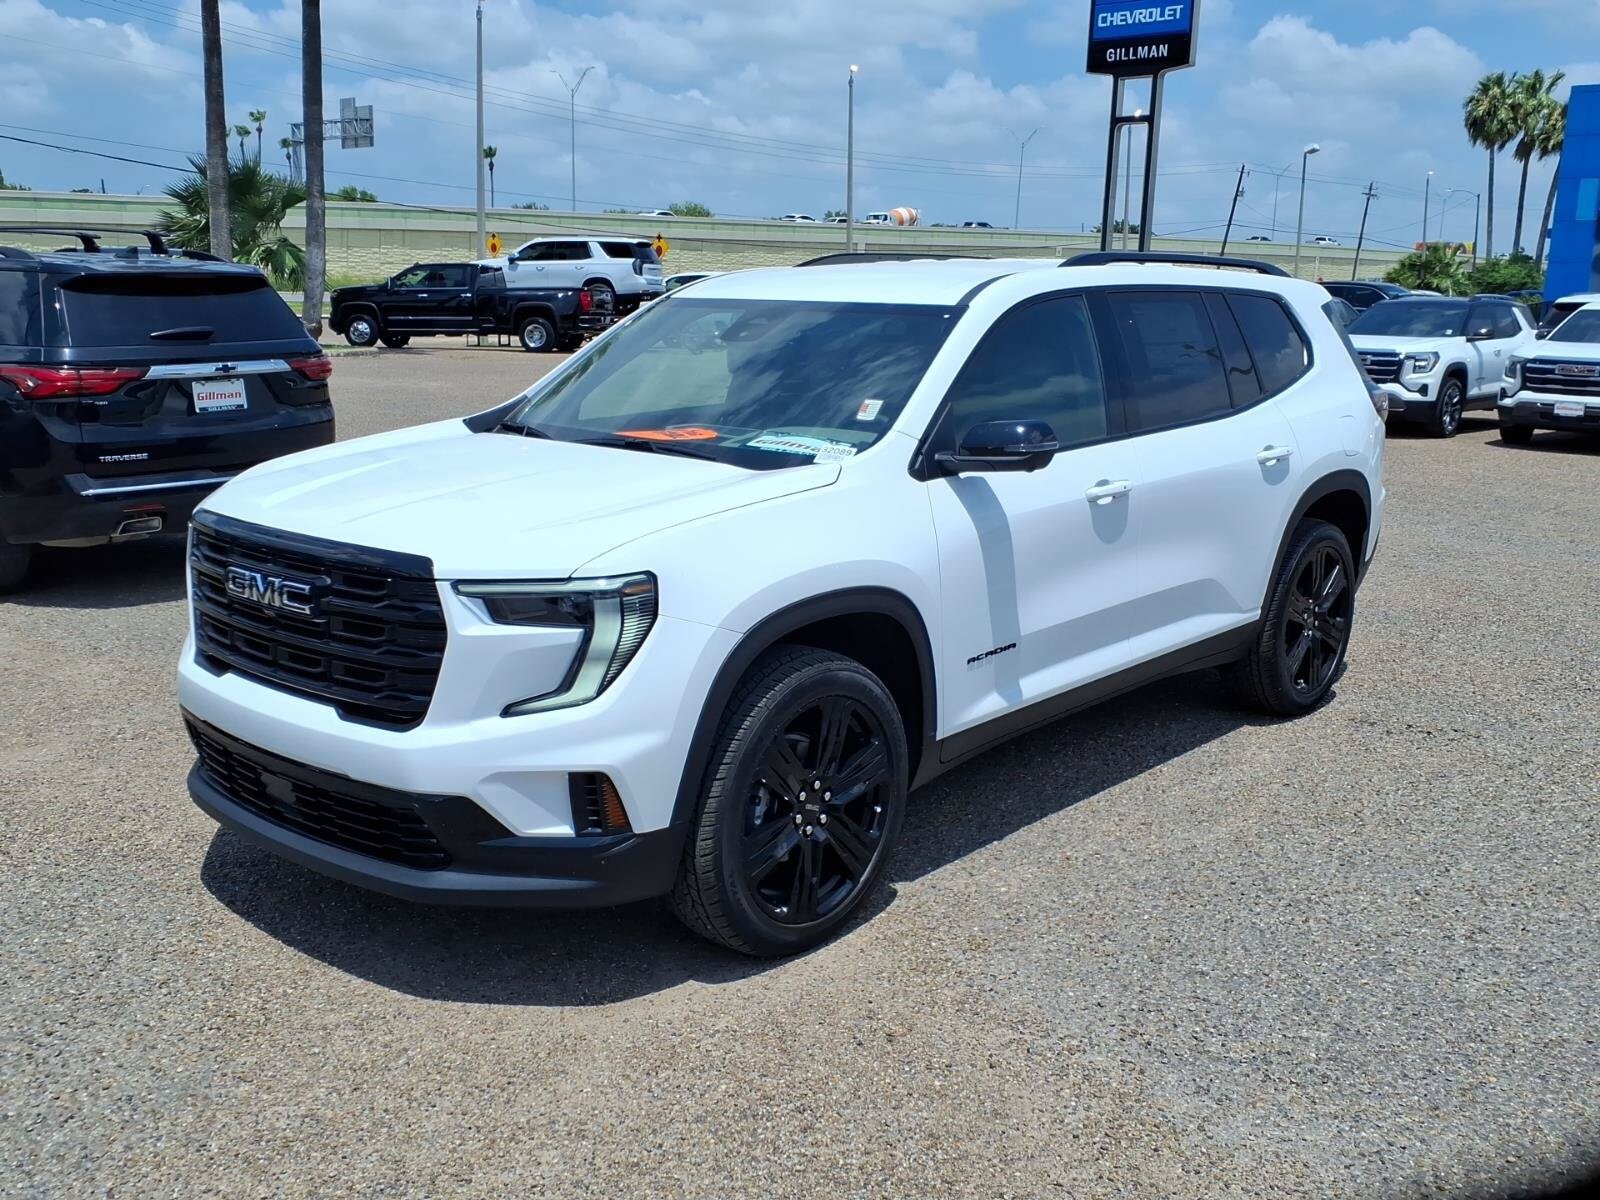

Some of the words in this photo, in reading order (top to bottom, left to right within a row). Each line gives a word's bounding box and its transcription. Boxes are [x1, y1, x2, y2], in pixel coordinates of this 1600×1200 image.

[1097, 5, 1184, 27] CHEVROLET
[1106, 44, 1168, 61] GILLMAN
[197, 391, 241, 400] Gillman
[98, 453, 149, 462] TRAVERSE
[821, 446, 853, 457] 32089
[225, 566, 314, 615] GMC
[967, 642, 1017, 664] ACADIA
